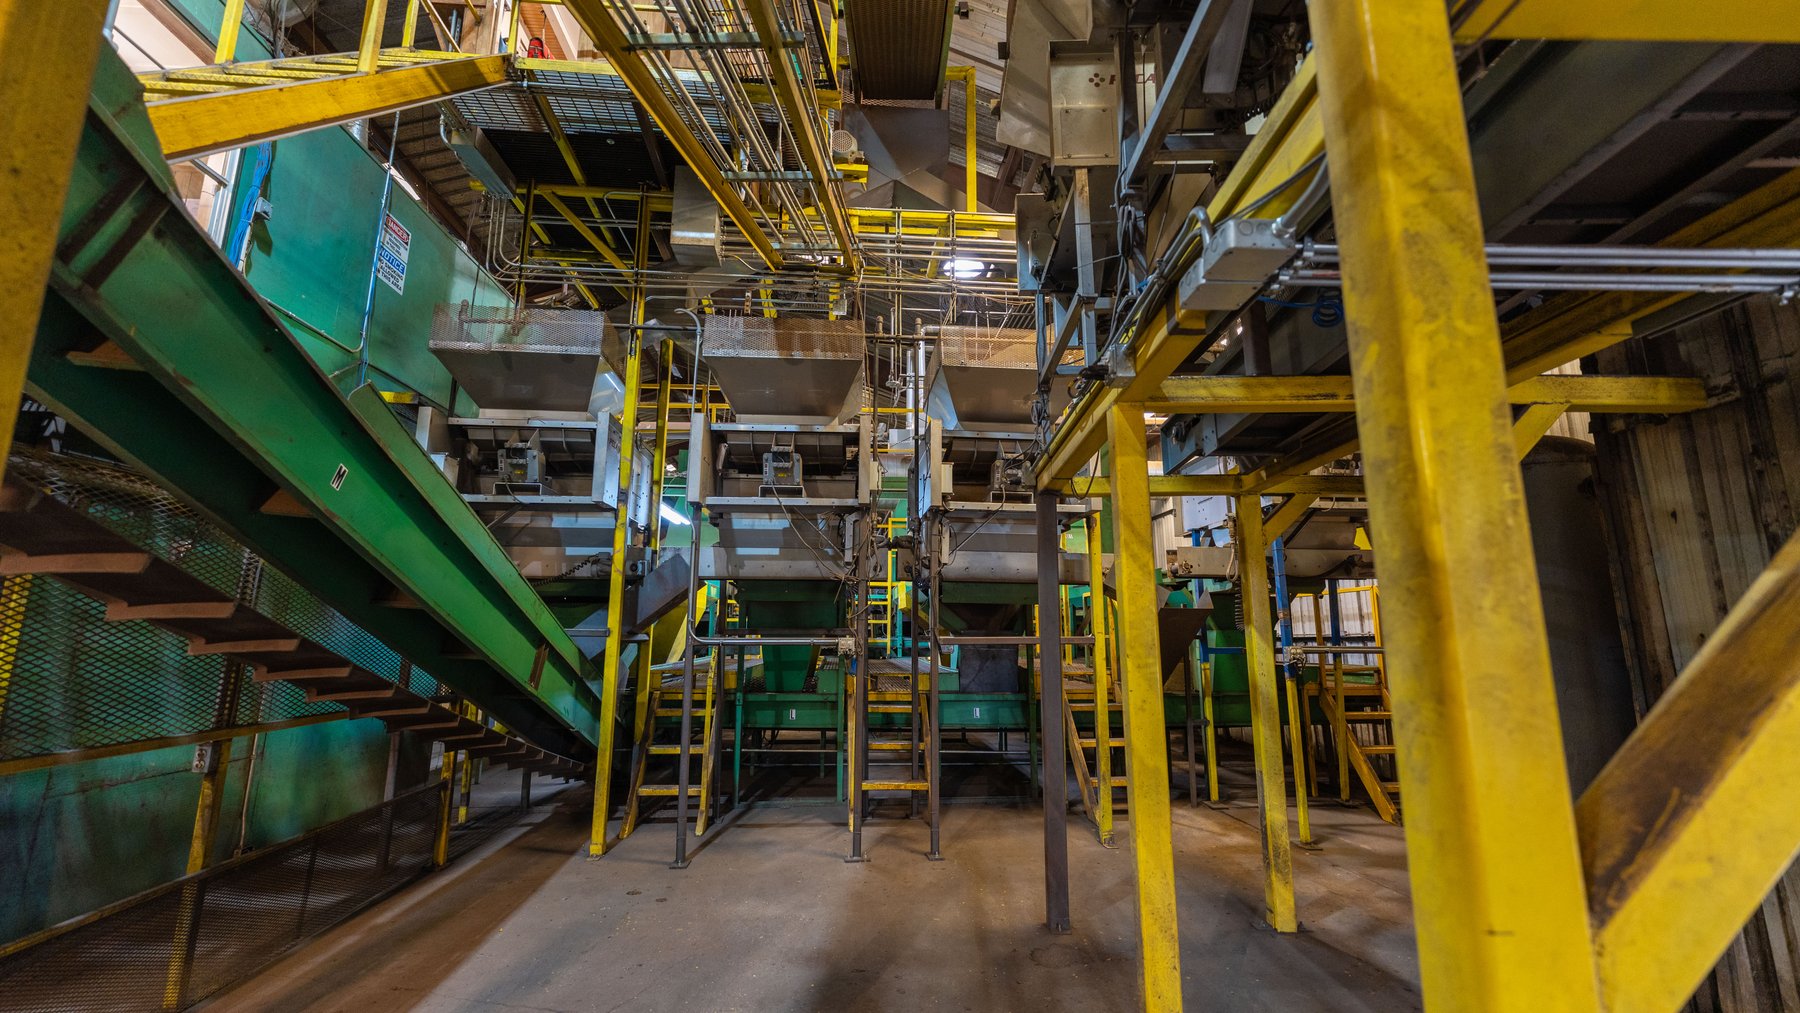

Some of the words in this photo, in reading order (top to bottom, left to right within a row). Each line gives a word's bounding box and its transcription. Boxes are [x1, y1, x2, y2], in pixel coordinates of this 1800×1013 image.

[380, 248, 405, 273] NOTICE
[379, 263, 399, 283] ALLOWED
[381, 271, 391, 284] THIS
[391, 279, 402, 292] AREA
[384, 262, 403, 281] SMOKING
[331, 464, 347, 490] M
